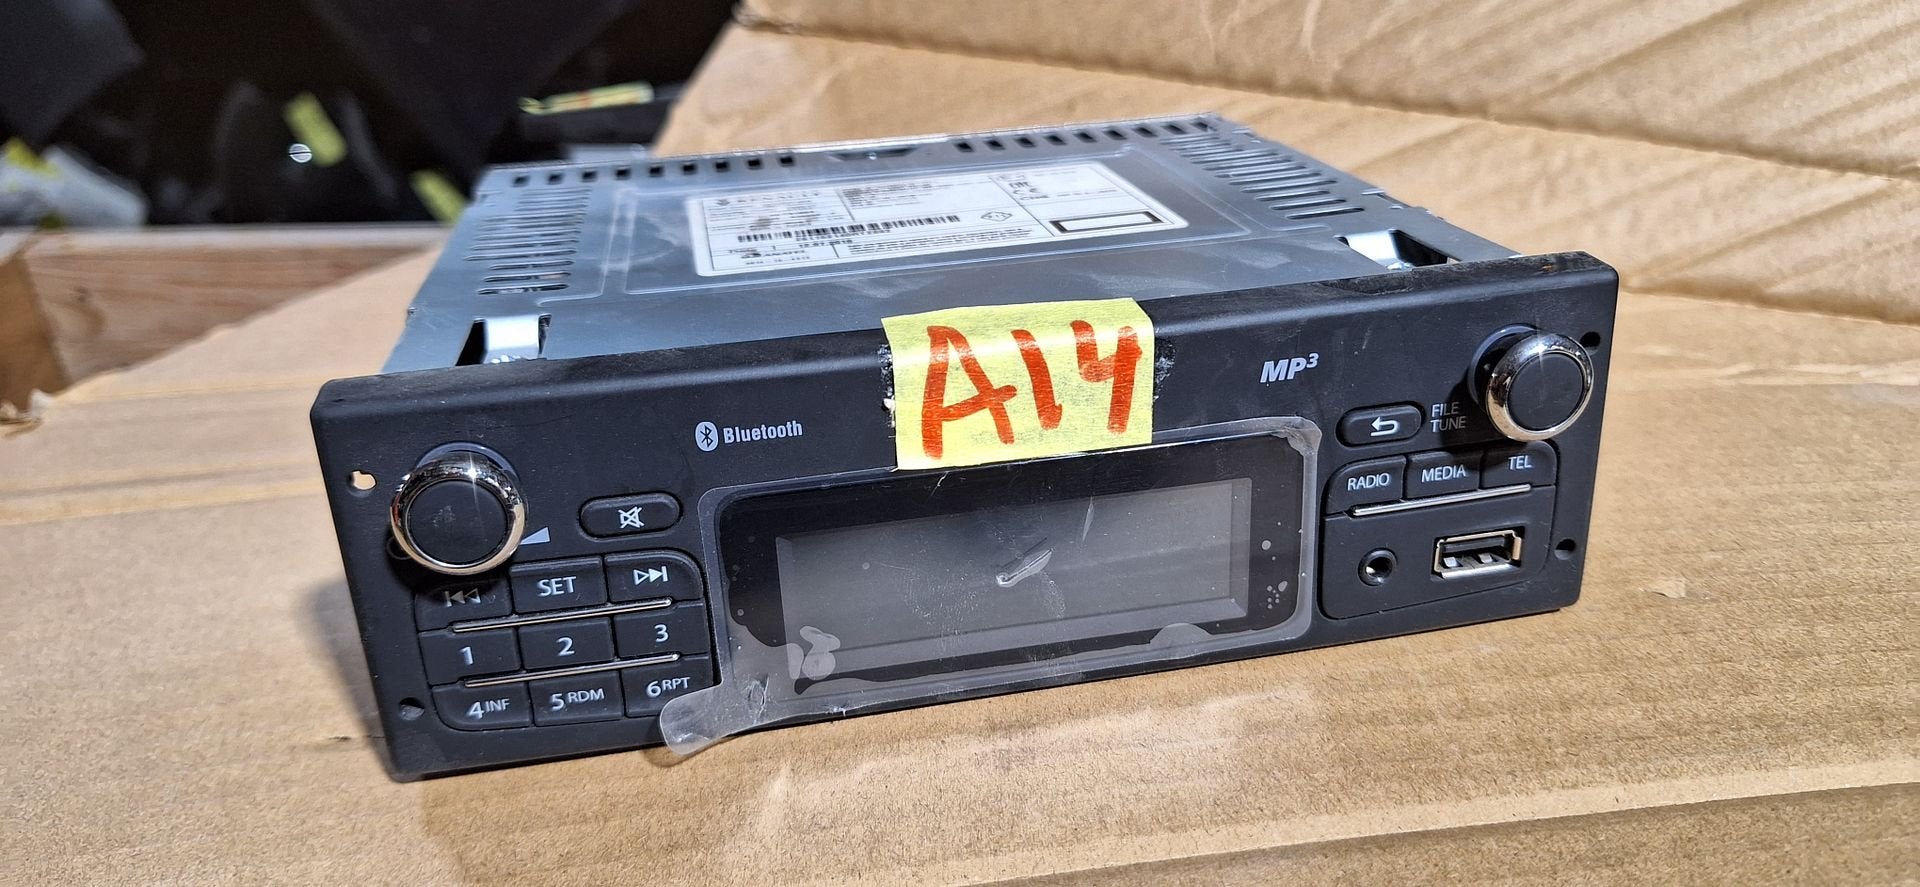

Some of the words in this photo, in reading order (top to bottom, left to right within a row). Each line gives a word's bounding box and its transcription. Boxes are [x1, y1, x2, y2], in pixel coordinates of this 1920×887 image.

[1259, 352, 1319, 384] MP3
[922, 320, 1142, 459] A14
[1431, 401, 1460, 418] FILE
[723, 420, 803, 444] Bluetooth
[1430, 416, 1467, 433] TUNE
[1421, 463, 1467, 483] MEDIA
[1508, 455, 1532, 471] TEL
[1347, 472, 1390, 492] RADIO
[536, 576, 577, 597] SET
[654, 624, 670, 643] 3
[461, 646, 474, 666] 1
[556, 636, 575, 657] 2
